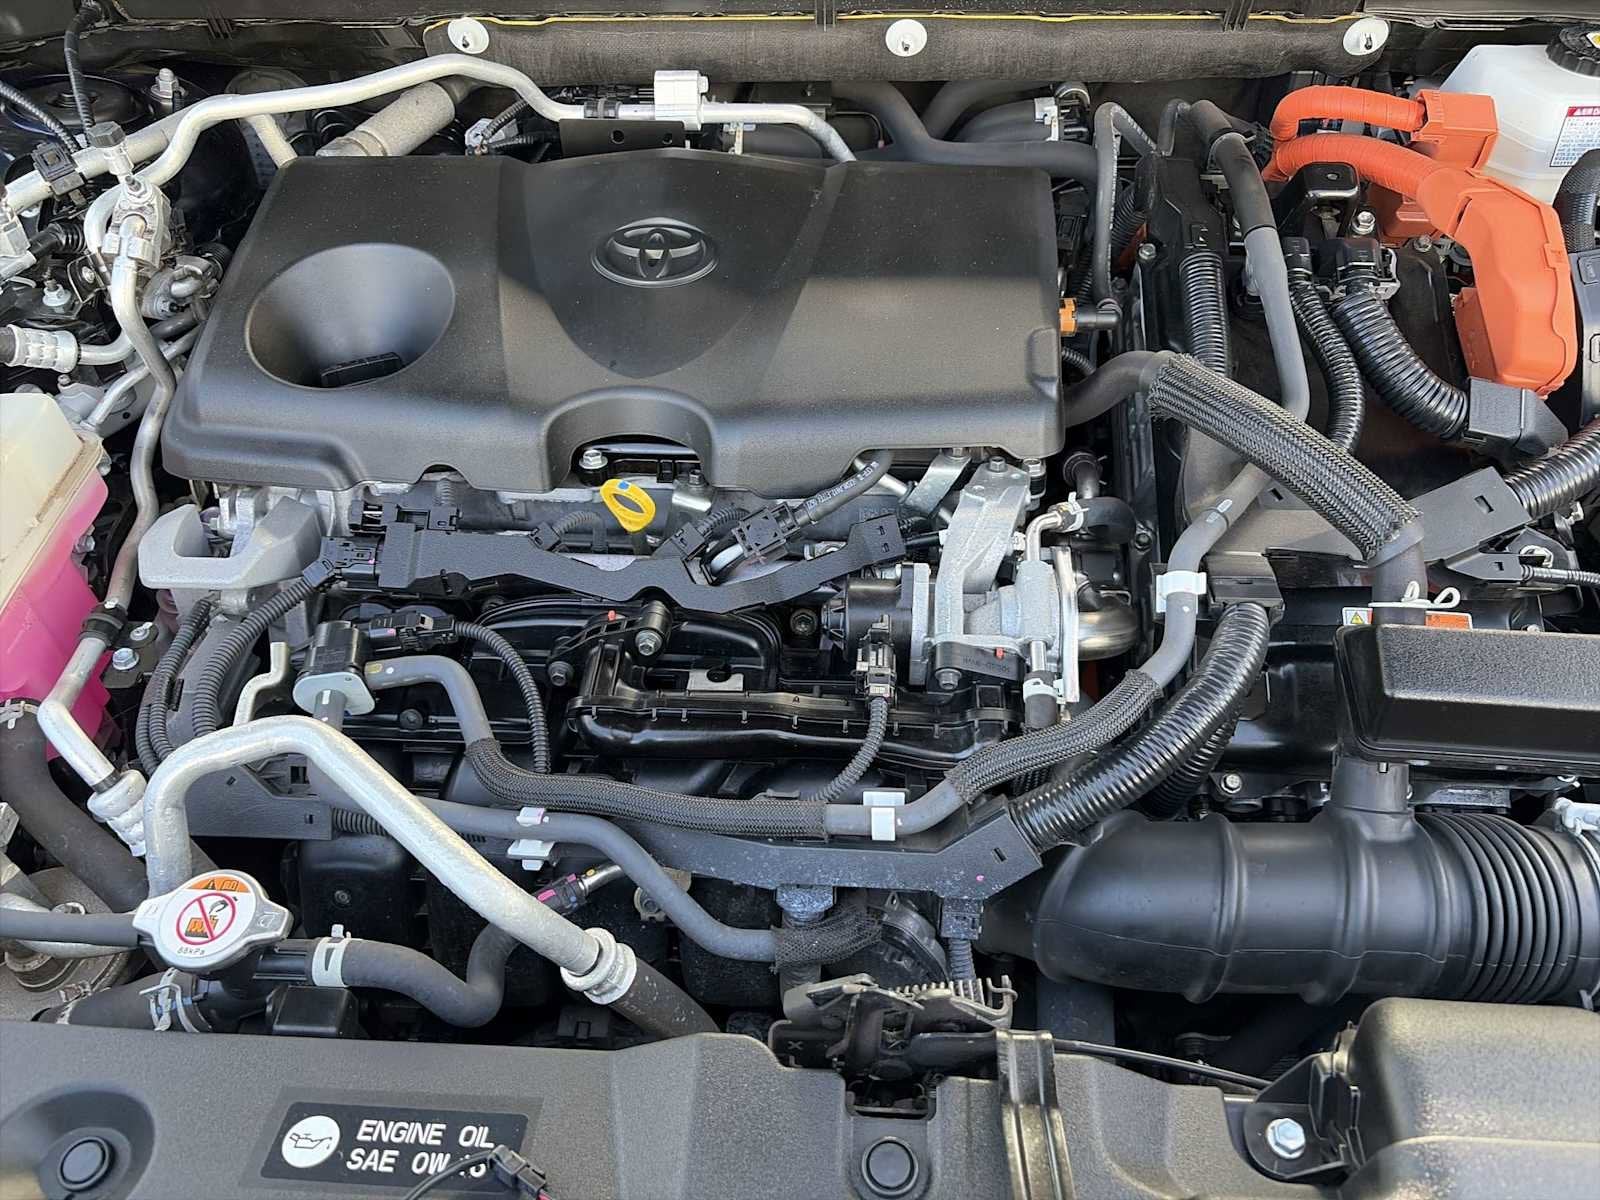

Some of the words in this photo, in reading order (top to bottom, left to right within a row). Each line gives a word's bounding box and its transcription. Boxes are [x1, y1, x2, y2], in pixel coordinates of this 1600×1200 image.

[356, 1119, 446, 1145] ENGINE
[459, 1125, 495, 1149] OIL
[346, 1148, 399, 1173] SAE
